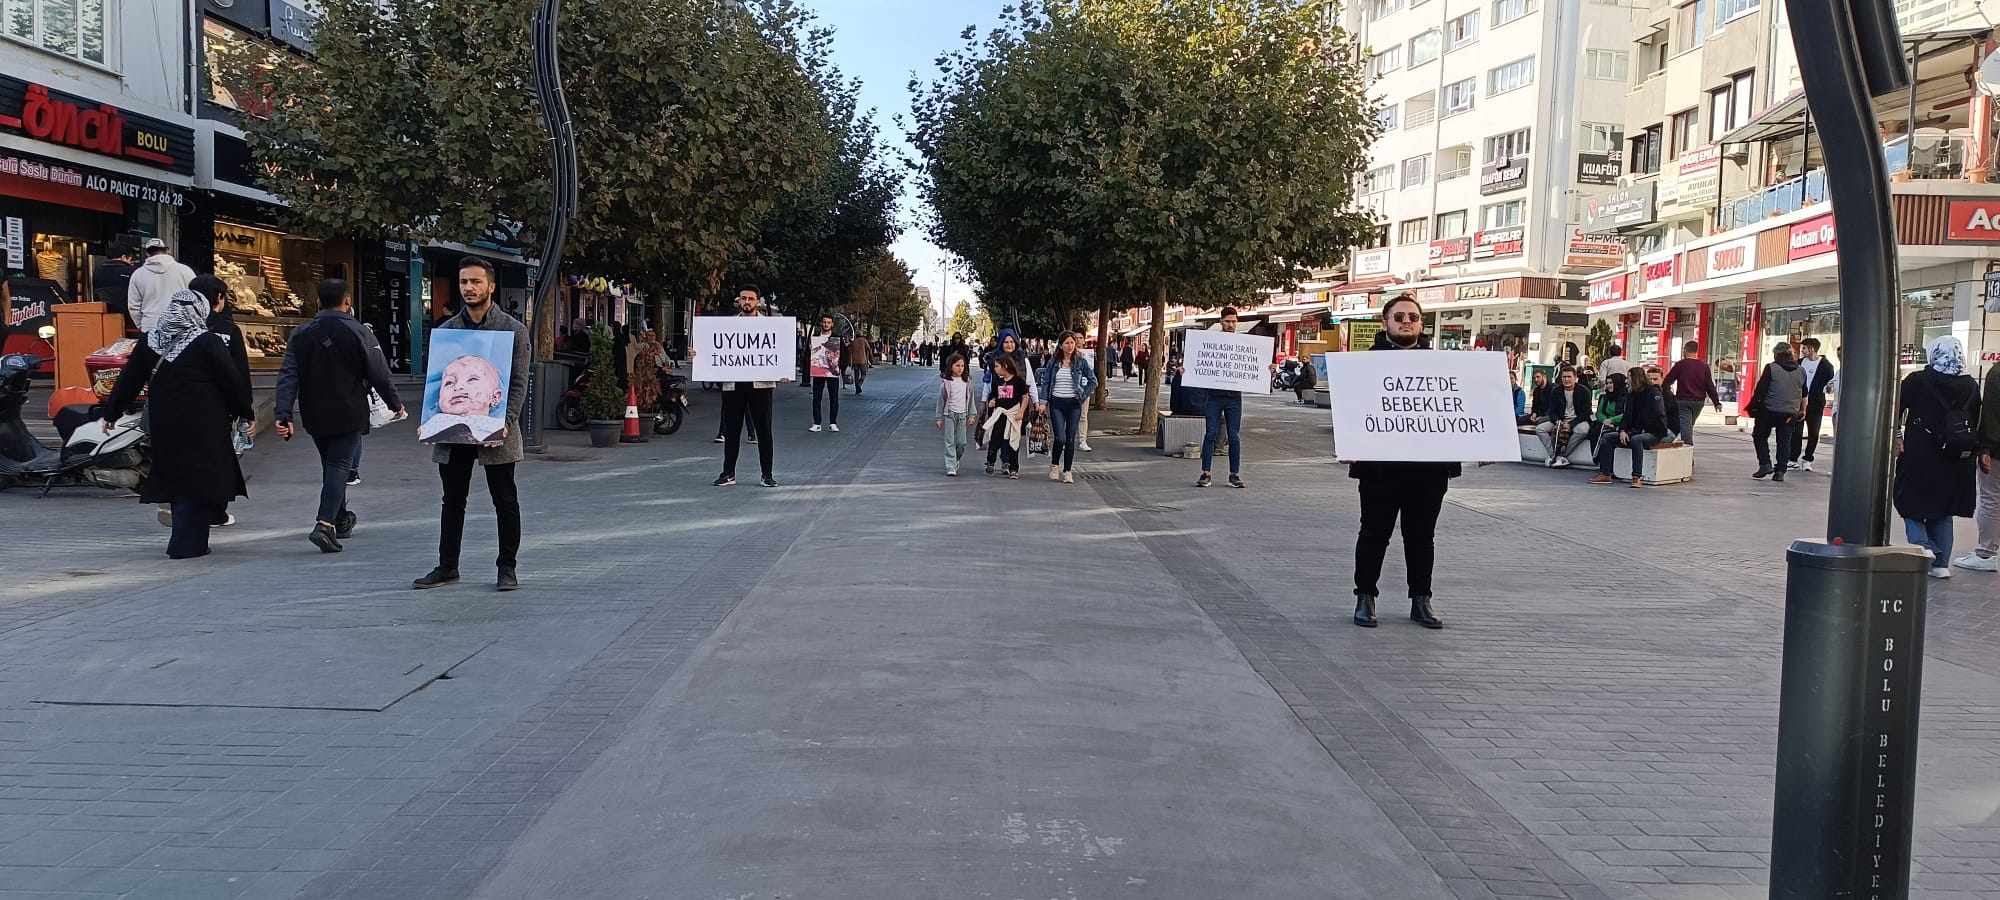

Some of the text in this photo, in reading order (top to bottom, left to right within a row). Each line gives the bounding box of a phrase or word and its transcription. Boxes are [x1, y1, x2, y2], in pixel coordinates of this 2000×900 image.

[137, 131, 168, 152] BOLU
[86, 174, 108, 192] ALO
[110, 180, 140, 198] PAKET
[142, 187, 157, 202] 213
[160, 191, 170, 204] 66
[173, 193, 183, 206] 28
[713, 332, 776, 349] UYUMA!
[712, 352, 778, 367] İNSANLIK!
[1383, 376, 1460, 392] GAZZE'DE
[1381, 396, 1464, 412] BEBEKLER
[1365, 413, 1485, 433] ÖLDÜRÜLÜYOR!
[1882, 638, 1894, 712] BOLU
